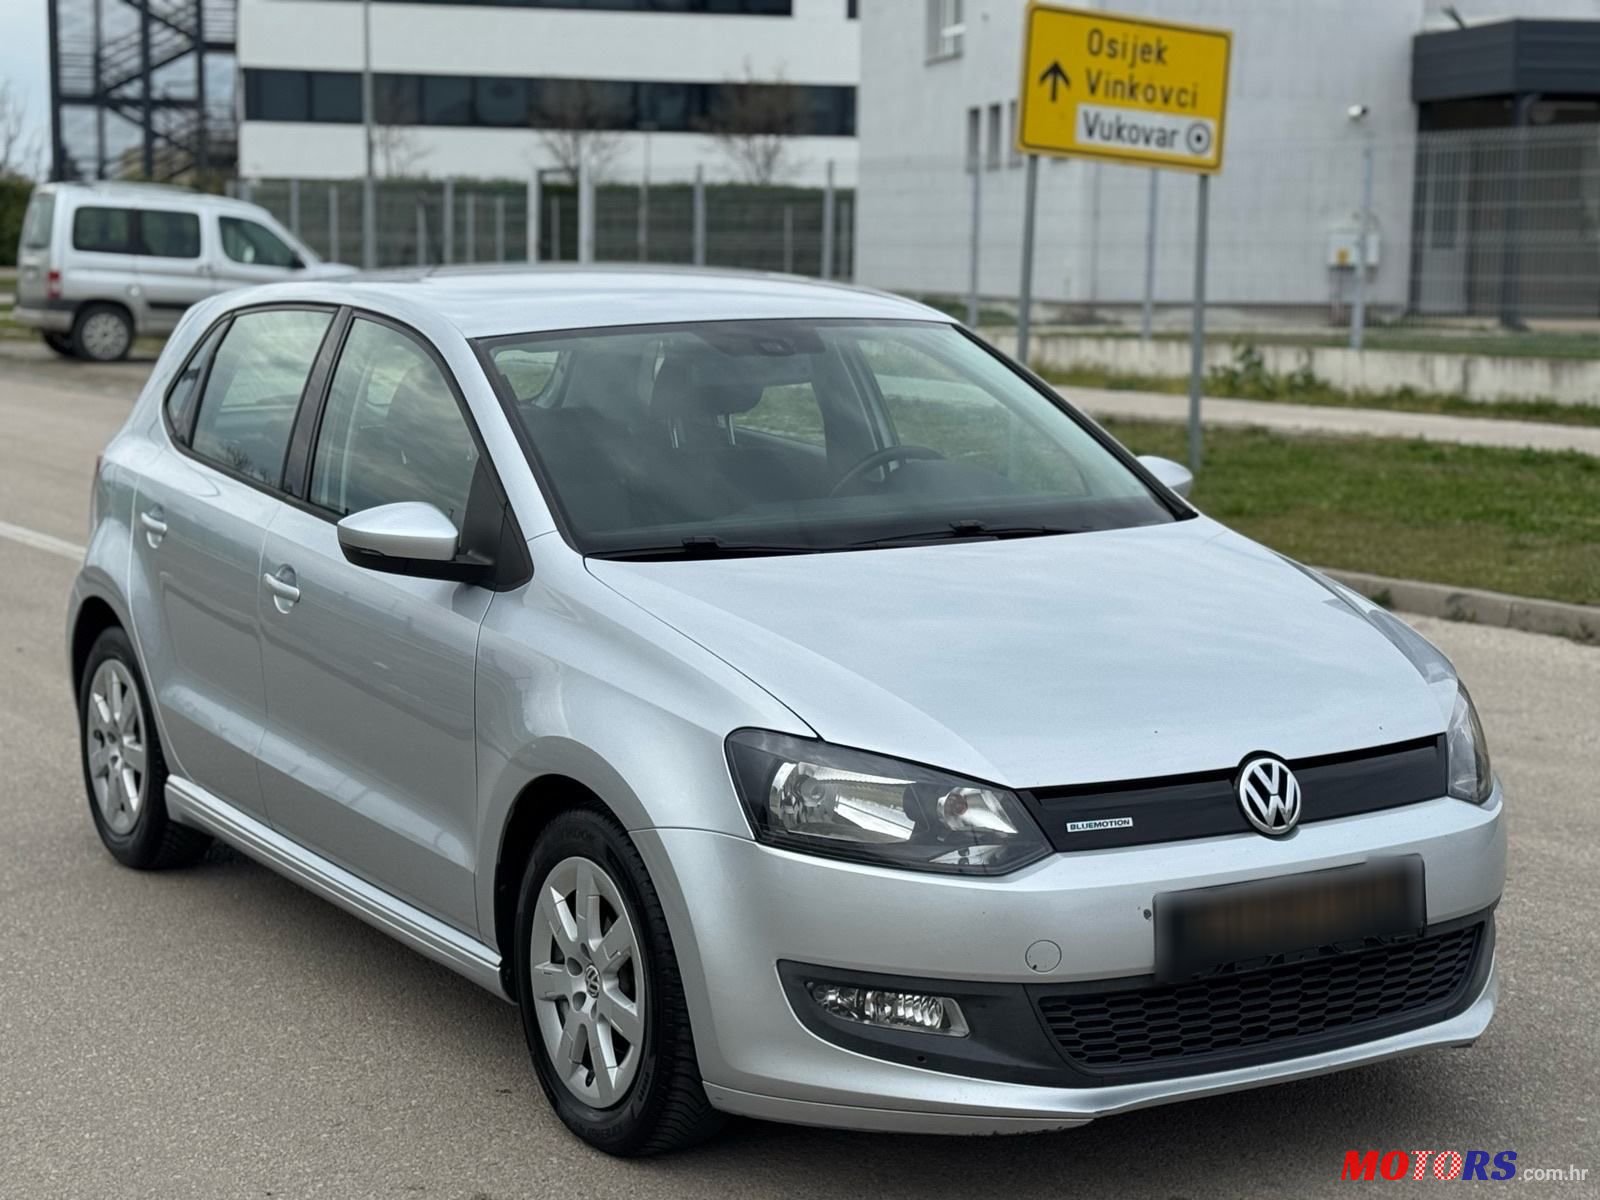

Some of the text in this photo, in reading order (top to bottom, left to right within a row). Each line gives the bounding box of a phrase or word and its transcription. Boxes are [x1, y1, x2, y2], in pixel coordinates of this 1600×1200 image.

[1087, 28, 1168, 68] Osijek
[1086, 68, 1199, 109] Vinkovci
[1083, 110, 1179, 149] Vukovar
[1241, 758, 1300, 833] VW
[1069, 819, 1131, 831] BLUEMOTION
